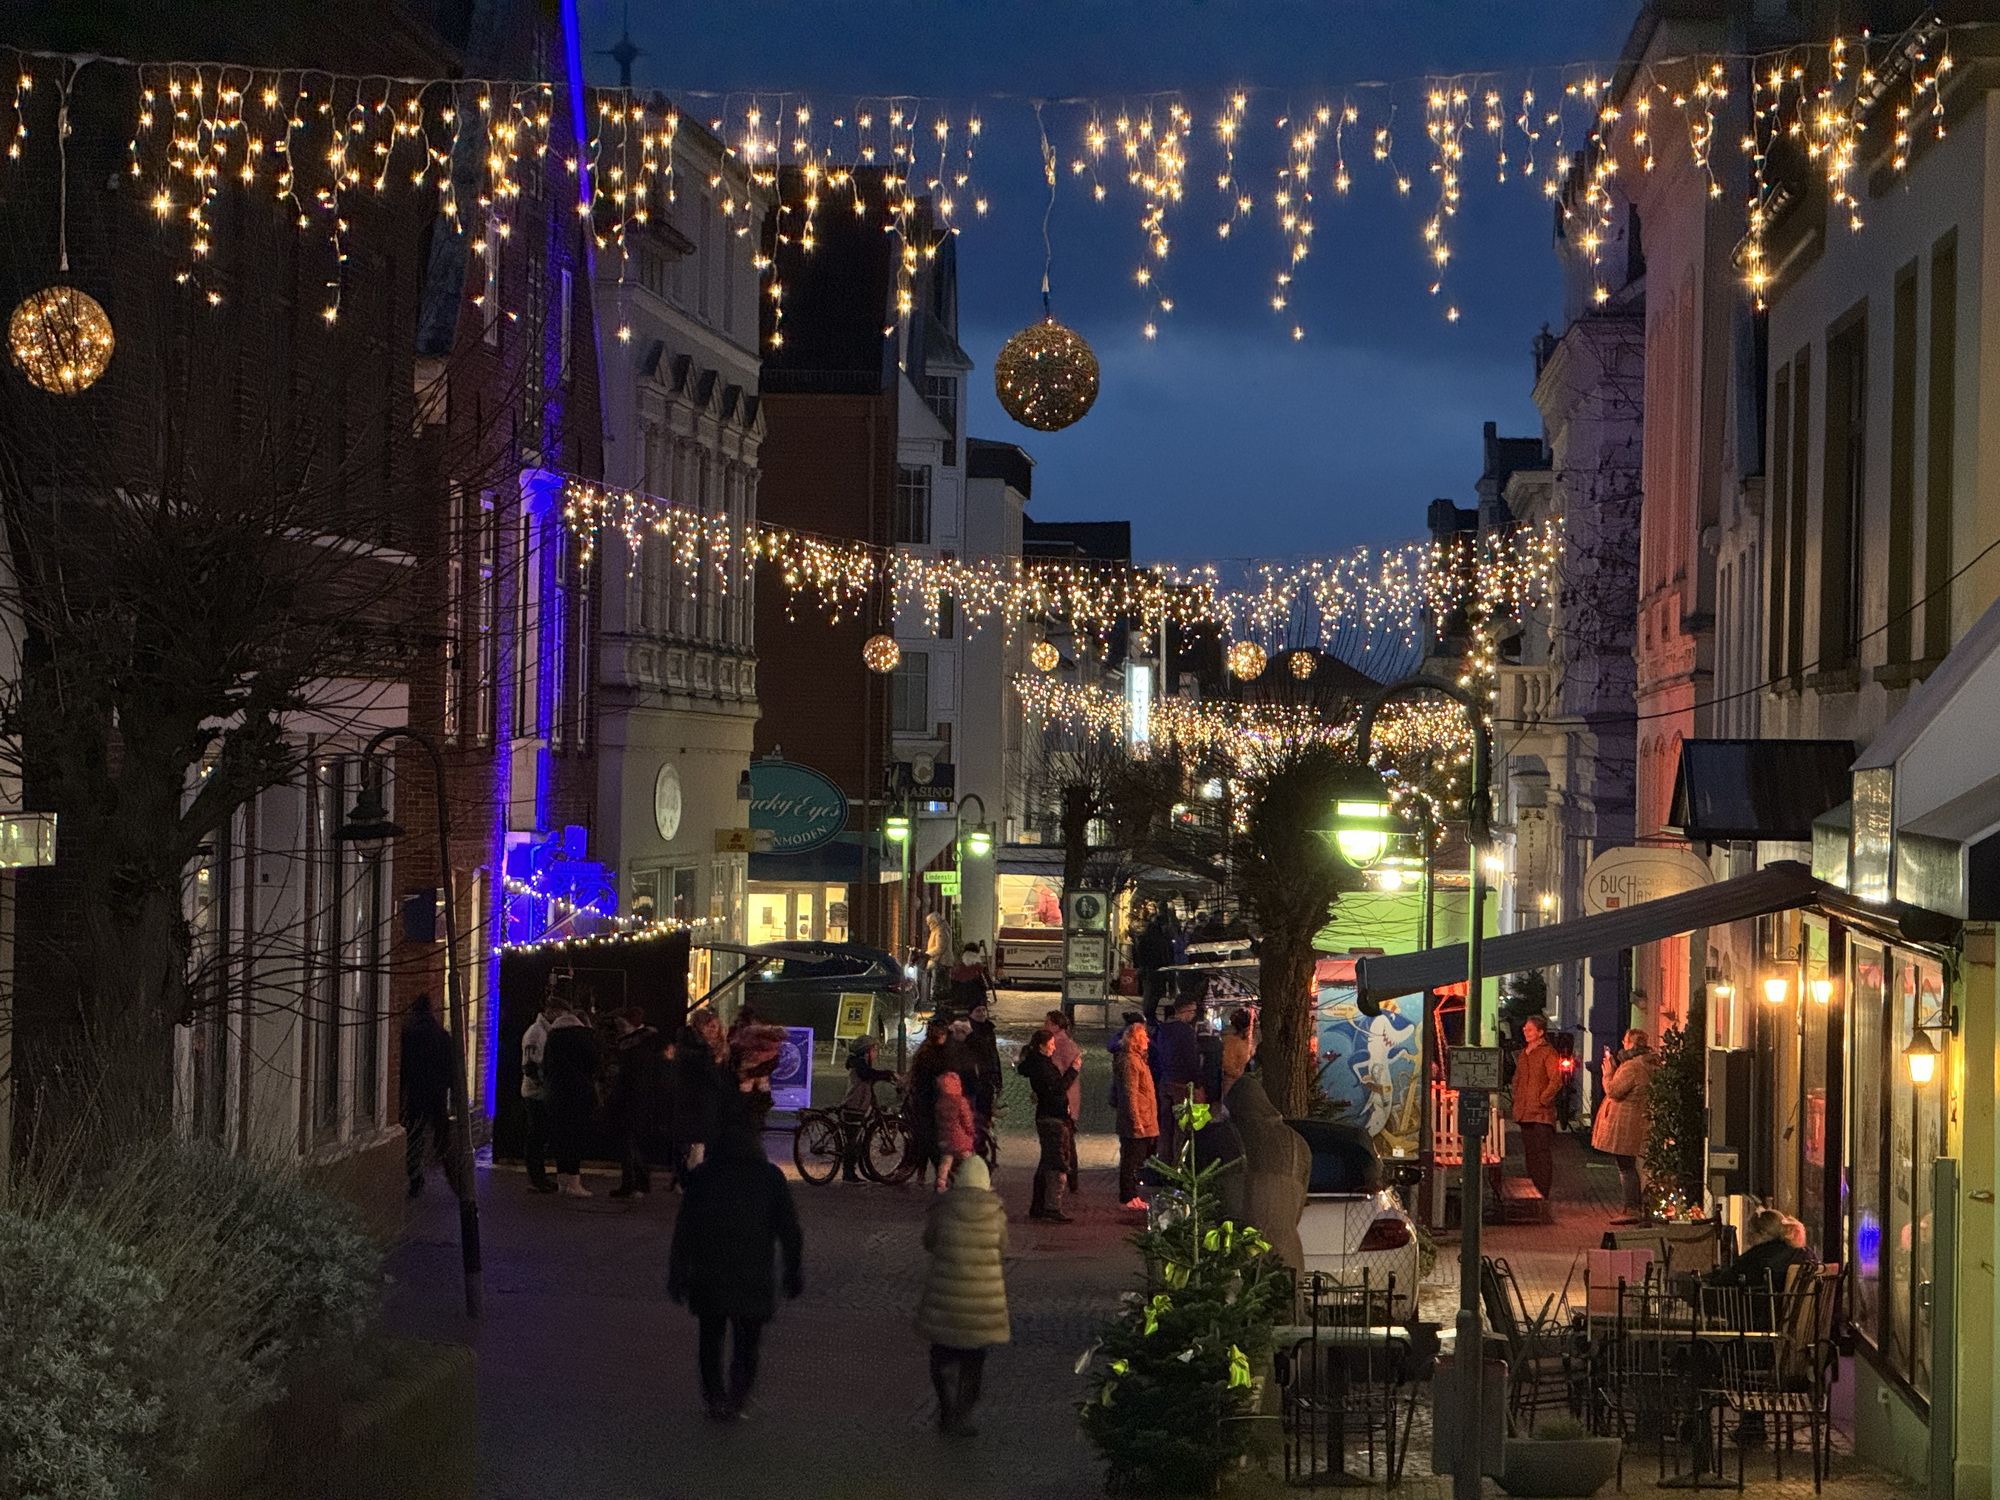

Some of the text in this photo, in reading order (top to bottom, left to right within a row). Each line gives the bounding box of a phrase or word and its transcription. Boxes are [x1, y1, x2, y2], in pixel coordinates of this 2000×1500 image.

[900, 786, 953, 799] CASINO
[750, 792, 794, 818] ucky
[773, 825, 827, 847] NMODEN
[1452, 1052, 1486, 1062] H 150
